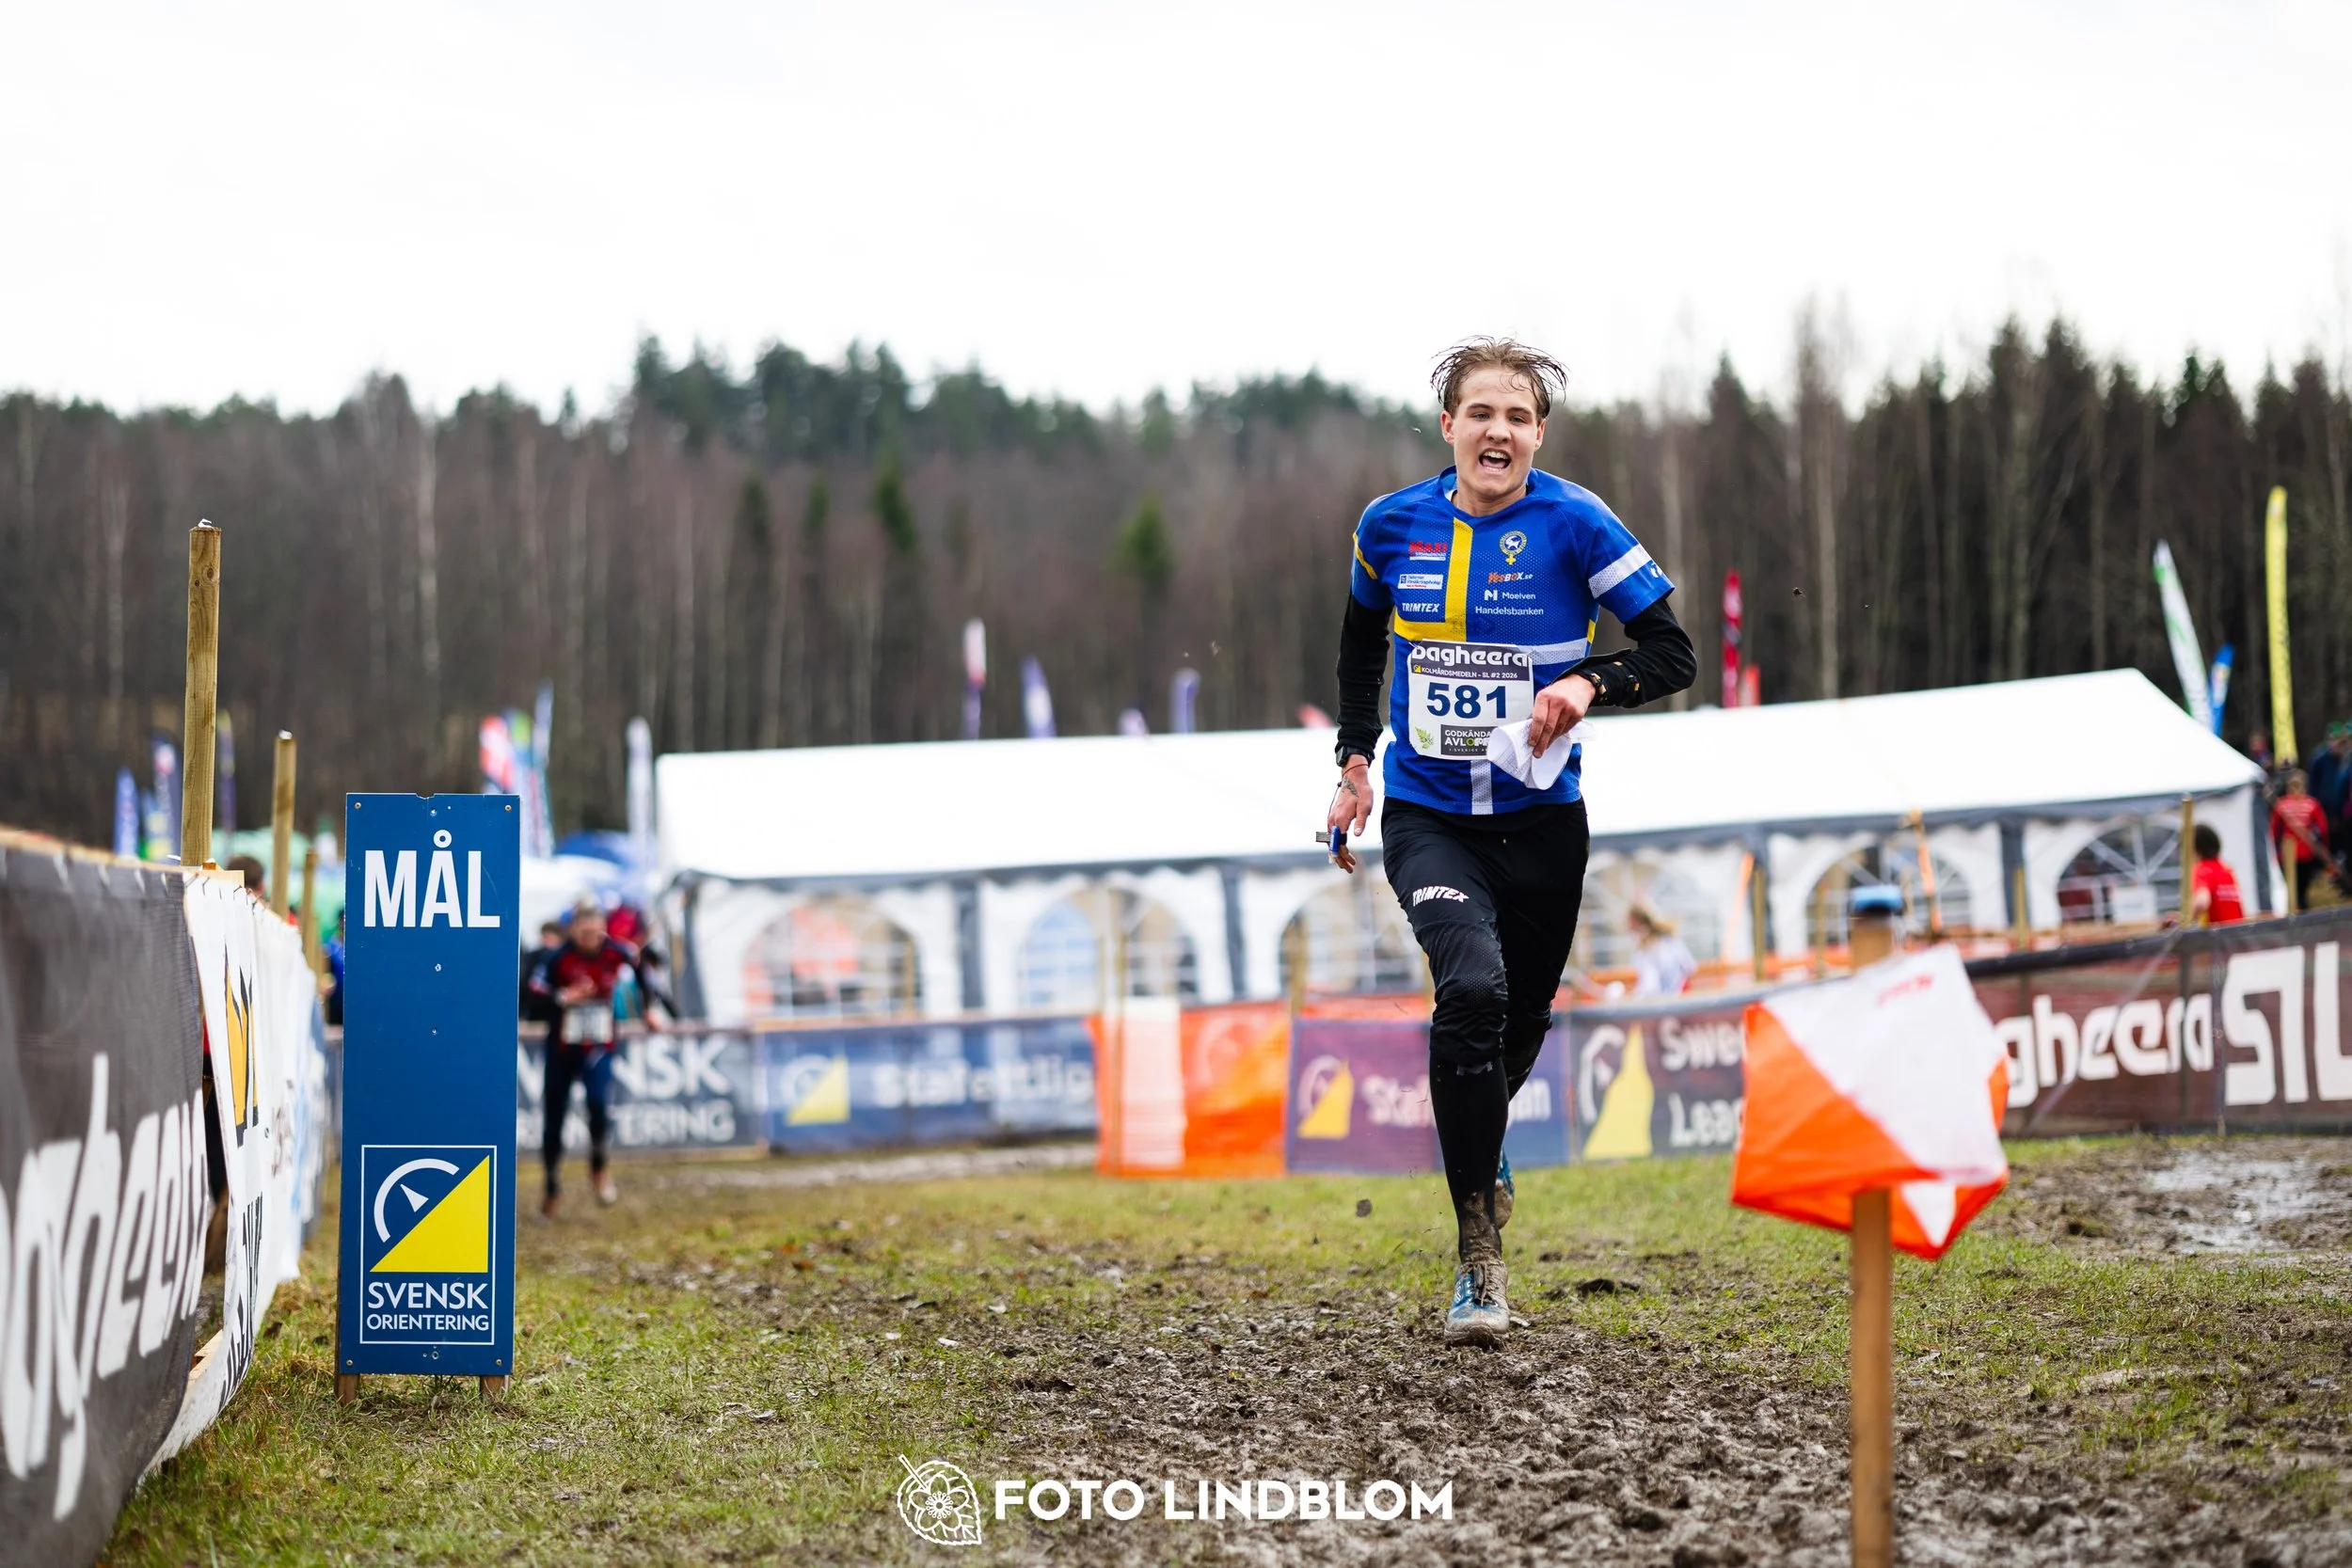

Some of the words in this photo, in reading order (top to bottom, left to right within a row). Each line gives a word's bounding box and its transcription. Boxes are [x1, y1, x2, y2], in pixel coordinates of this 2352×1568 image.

[1402, 603, 1439, 612] TRIMTEX
[1475, 607, 1544, 615] Handelsbanken
[1422, 667, 1477, 677] KOLMÅRDSMEDELN
[1426, 682, 1506, 719] 581
[364, 830, 501, 927] MÅL
[1412, 885, 1470, 907] TRIMTEX
[1660, 1016, 1747, 1071] Swe
[368, 1282, 488, 1309] SVENSK
[367, 1313, 489, 1332] ORIENTERING
